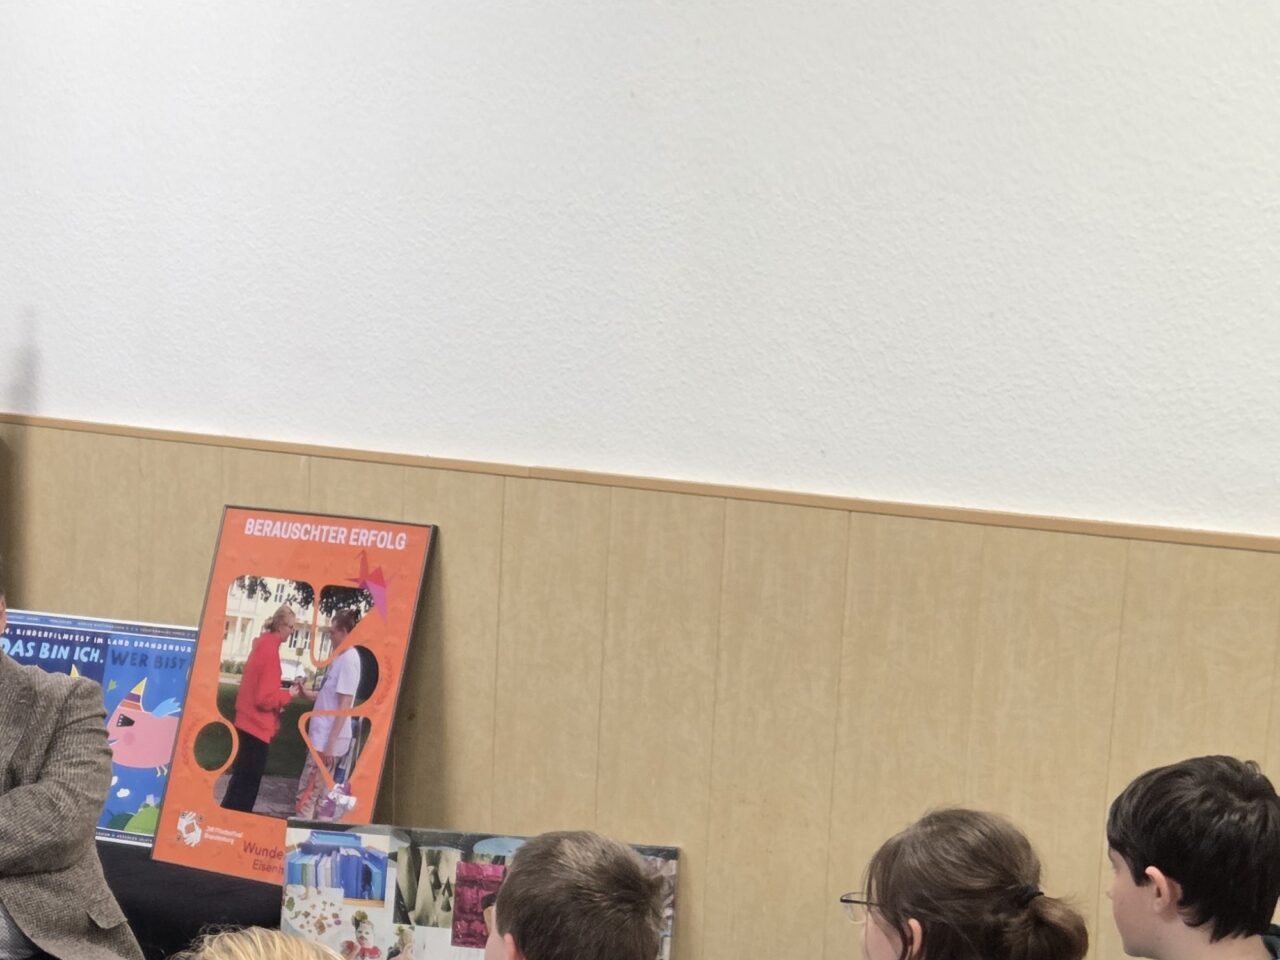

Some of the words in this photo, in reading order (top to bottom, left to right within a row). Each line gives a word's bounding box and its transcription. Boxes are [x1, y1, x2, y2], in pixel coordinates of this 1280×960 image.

[244, 518, 347, 545] BERAUSCHTER
[348, 528, 407, 550] ERFOLG
[16, 628, 90, 642] KINDERFILMFEST
[94, 636, 104, 644] IM
[107, 639, 130, 647] LAND
[0, 637, 36, 657] DAS
[38, 642, 70, 660] BIN
[73, 646, 104, 663] ICH.
[111, 649, 149, 668] WER
[153, 655, 187, 670] BIST
